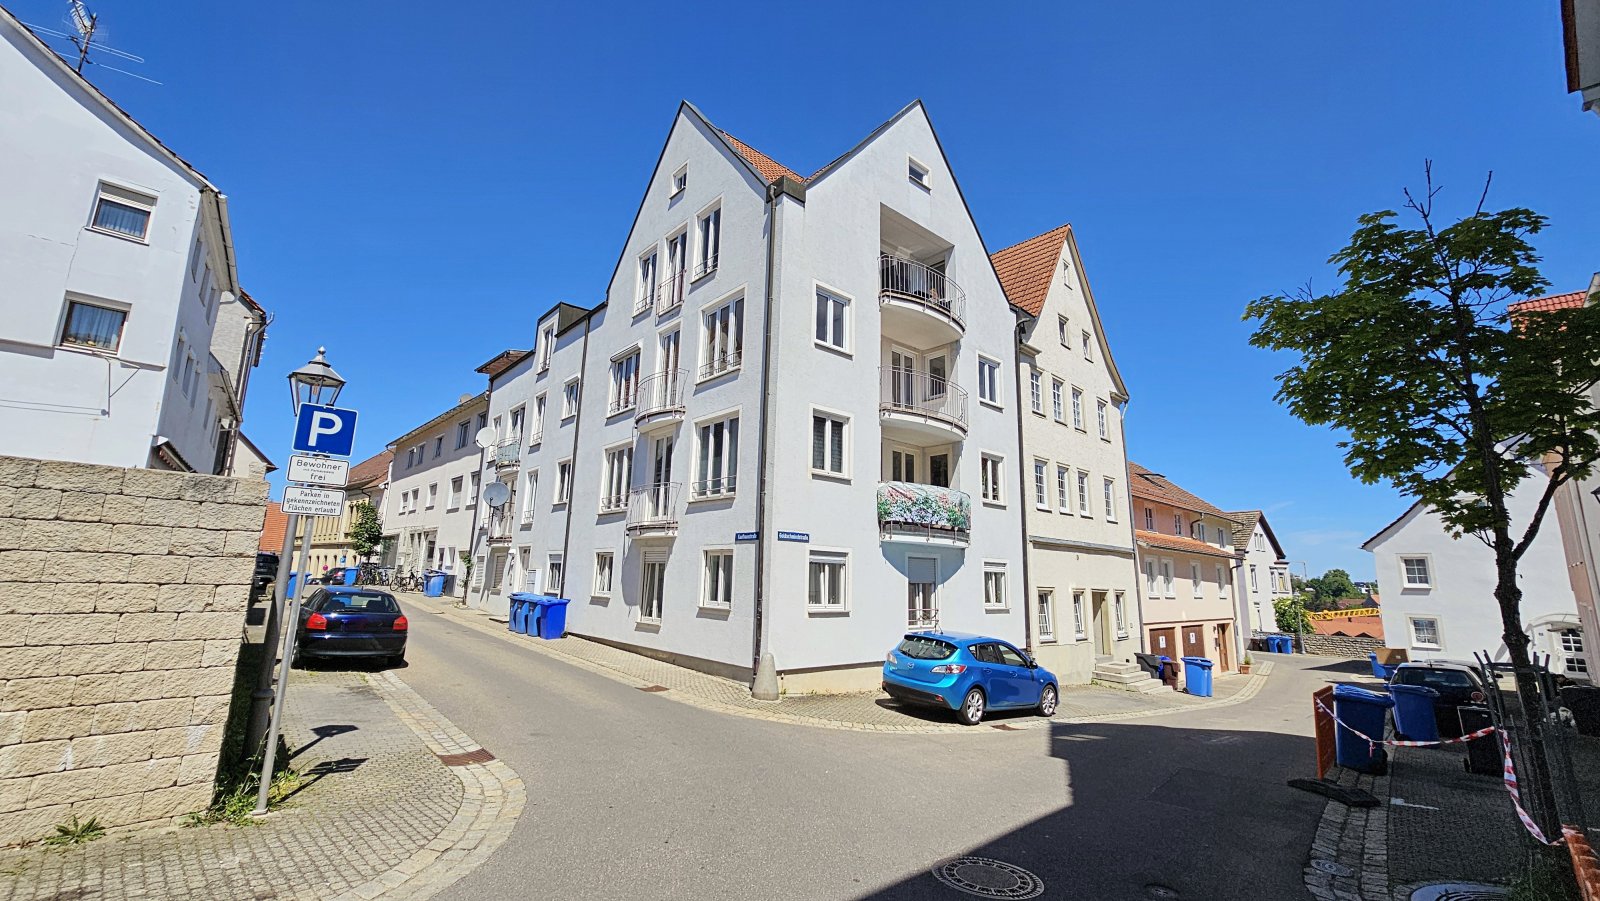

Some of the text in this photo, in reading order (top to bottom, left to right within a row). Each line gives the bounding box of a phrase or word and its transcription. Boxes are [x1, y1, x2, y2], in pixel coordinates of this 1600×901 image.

[308, 411, 342, 446] P
[296, 460, 341, 470] Bewohner
[310, 473, 326, 481] frei
[300, 490, 330, 499] Parken in
[286, 497, 341, 507] gekennzeichneten
[288, 503, 336, 514] Flächen erlaubt
